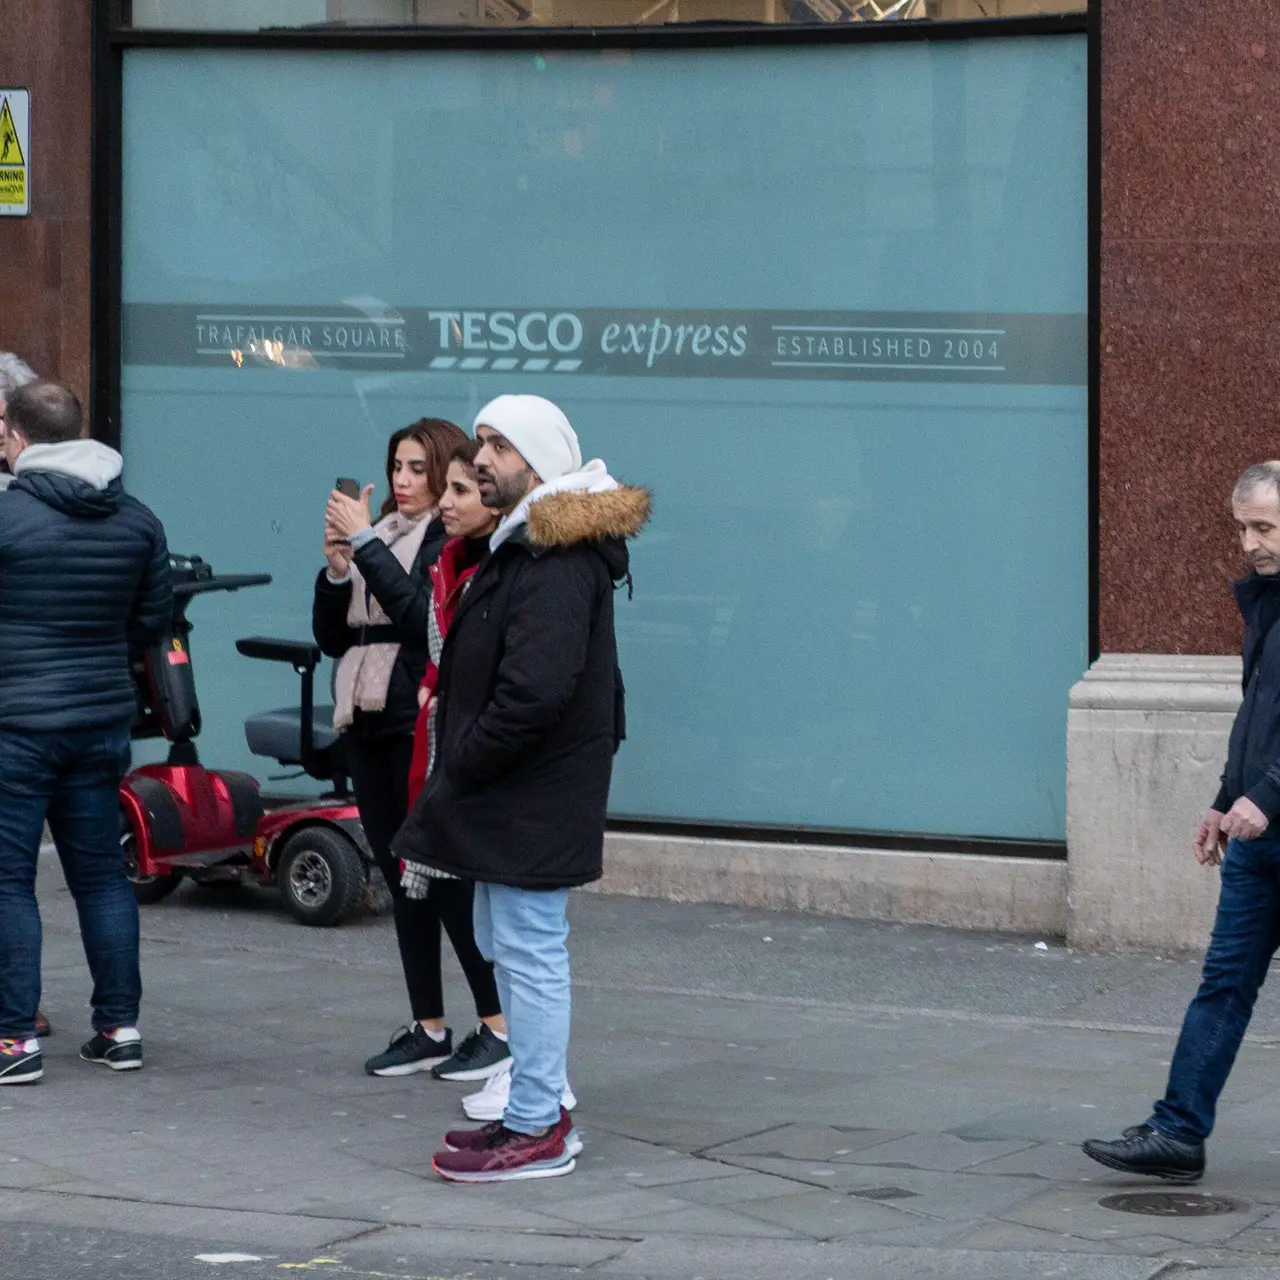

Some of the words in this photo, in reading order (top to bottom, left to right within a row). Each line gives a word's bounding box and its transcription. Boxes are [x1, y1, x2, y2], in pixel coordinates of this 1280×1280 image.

[196, 324, 312, 346] TRAFALGAR
[323, 327, 404, 348] SQUARE
[428, 311, 583, 352] TESCO
[601, 318, 747, 368] express
[777, 337, 931, 358] ESTABLISHED
[944, 340, 999, 359] 2004
